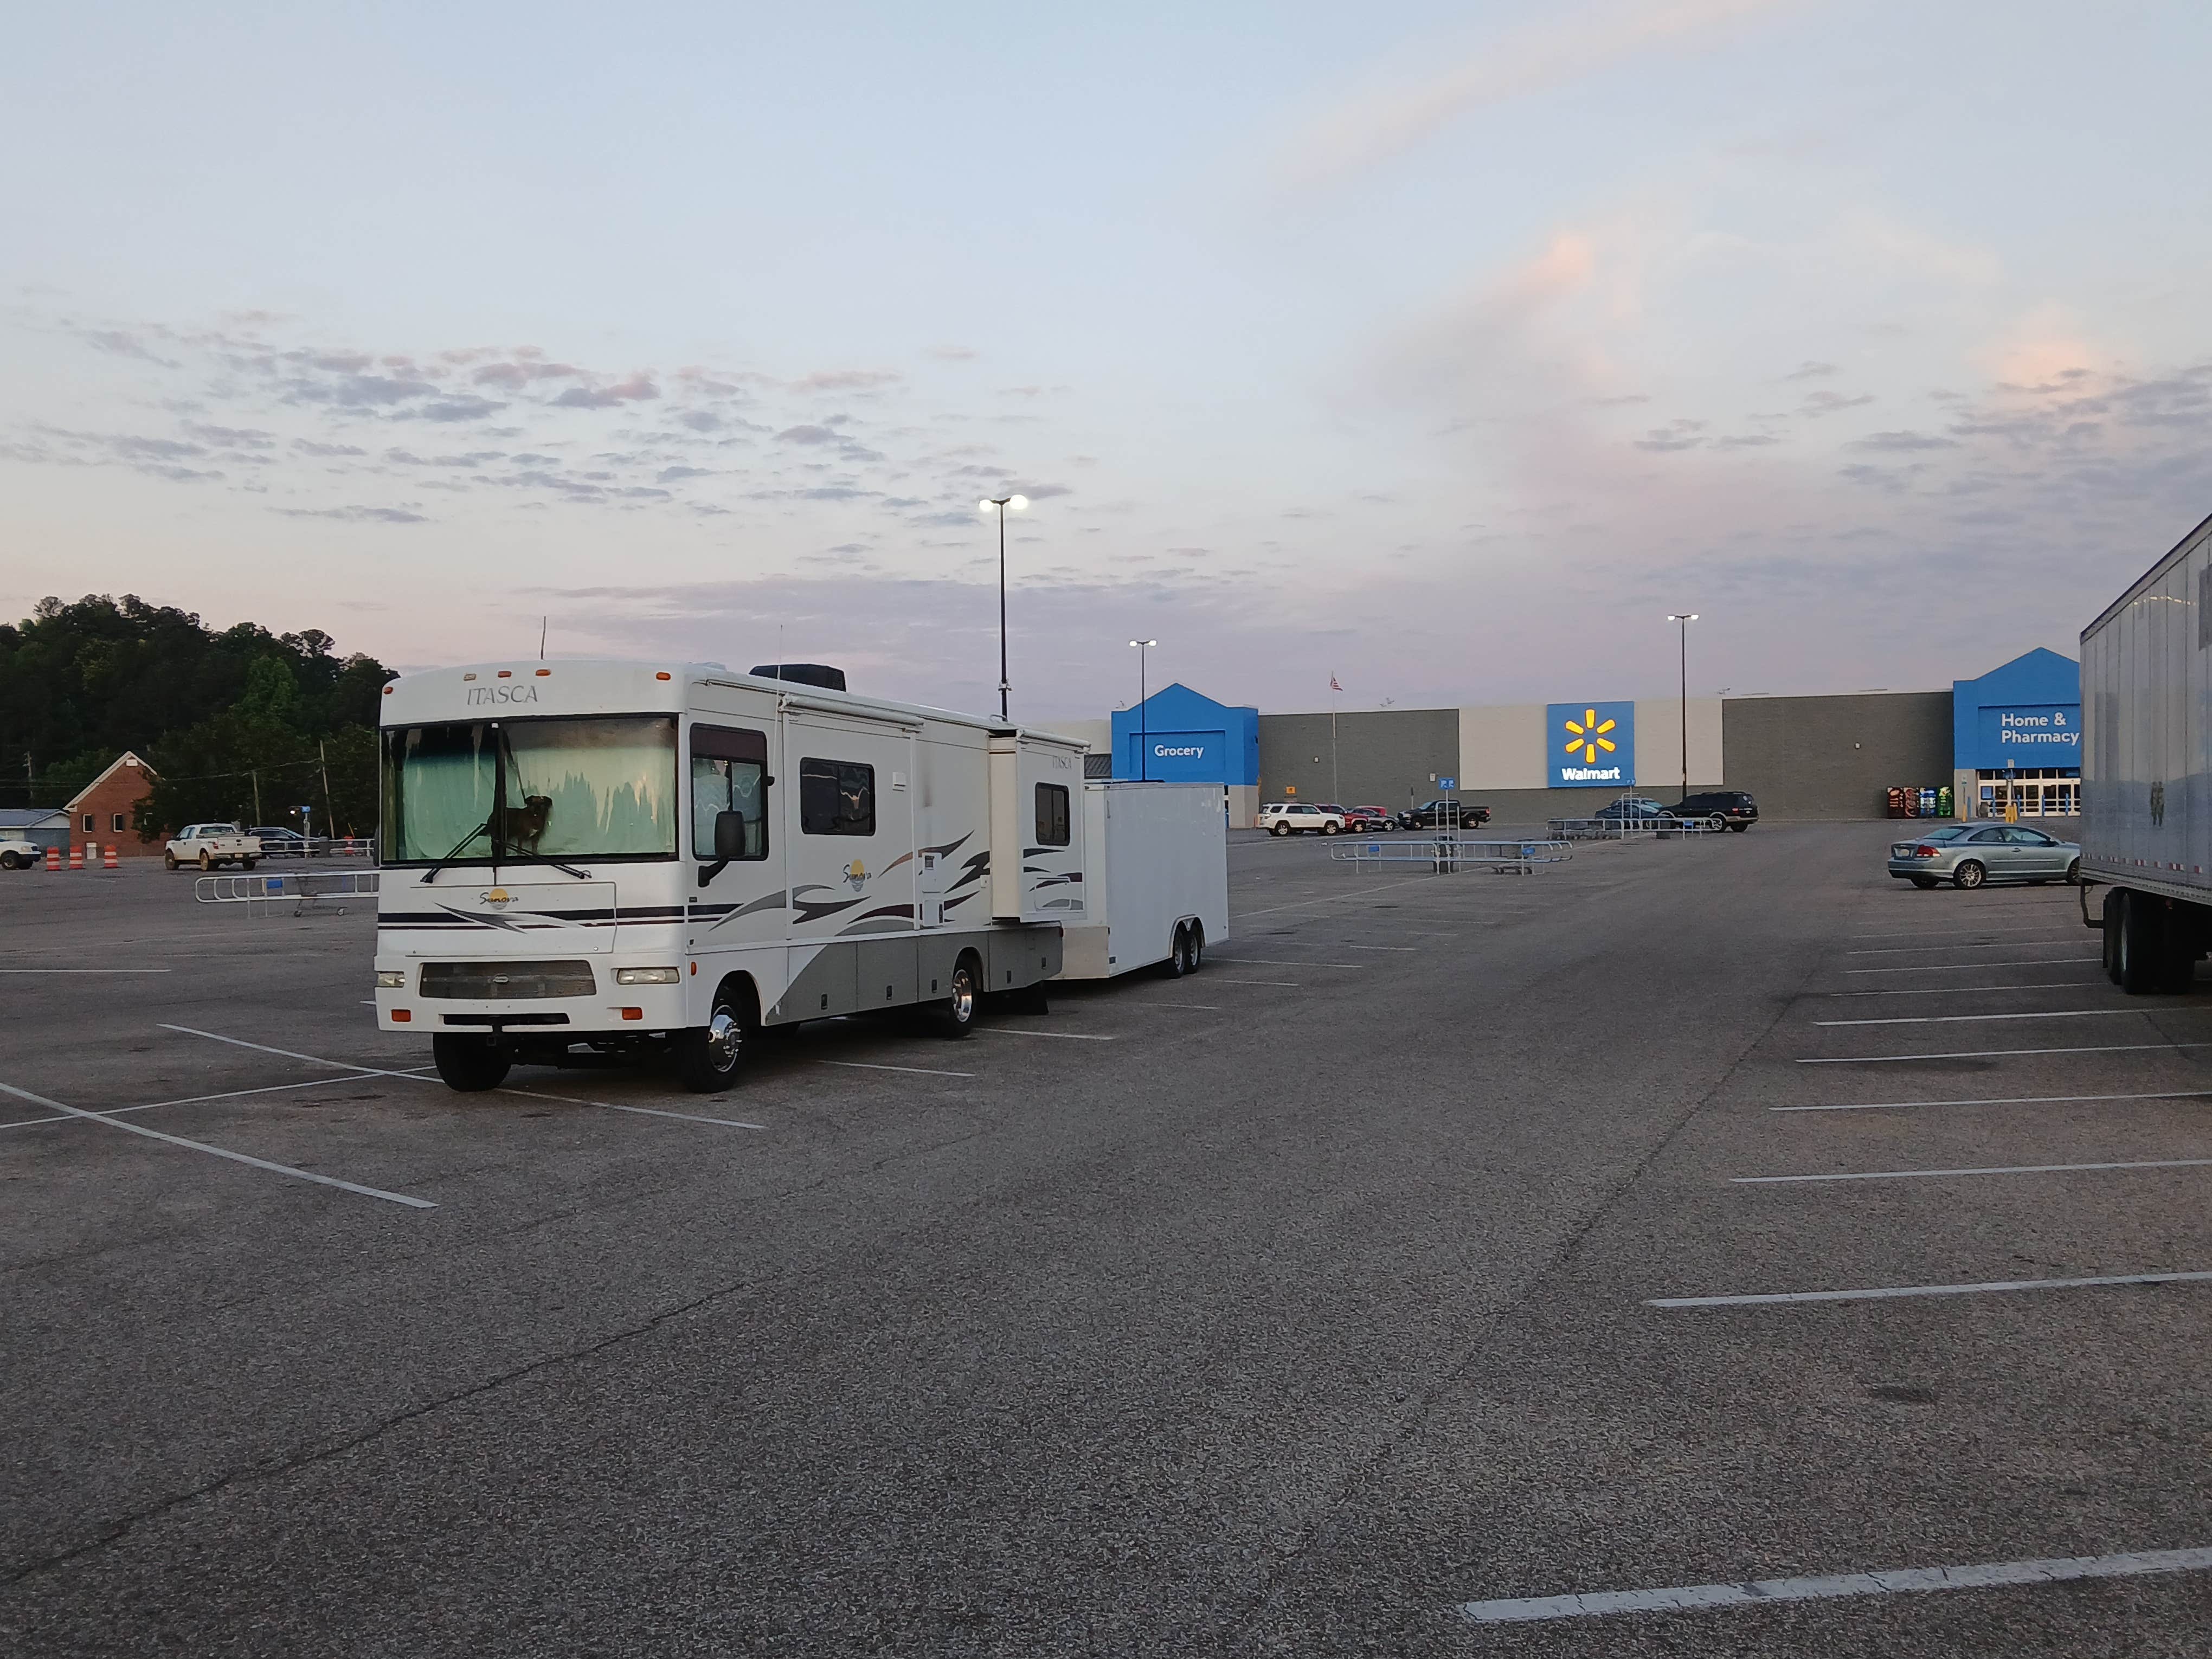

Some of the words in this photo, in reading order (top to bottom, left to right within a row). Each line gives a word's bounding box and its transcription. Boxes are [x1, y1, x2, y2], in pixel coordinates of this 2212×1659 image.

[467, 685, 538, 705] ITASCA
[2001, 713, 2049, 726] Home
[2054, 712, 2067, 726] &
[2001, 730, 2080, 746] Pharmacy
[1154, 744, 1204, 759] Grocery
[1561, 767, 1621, 781] Walmart
